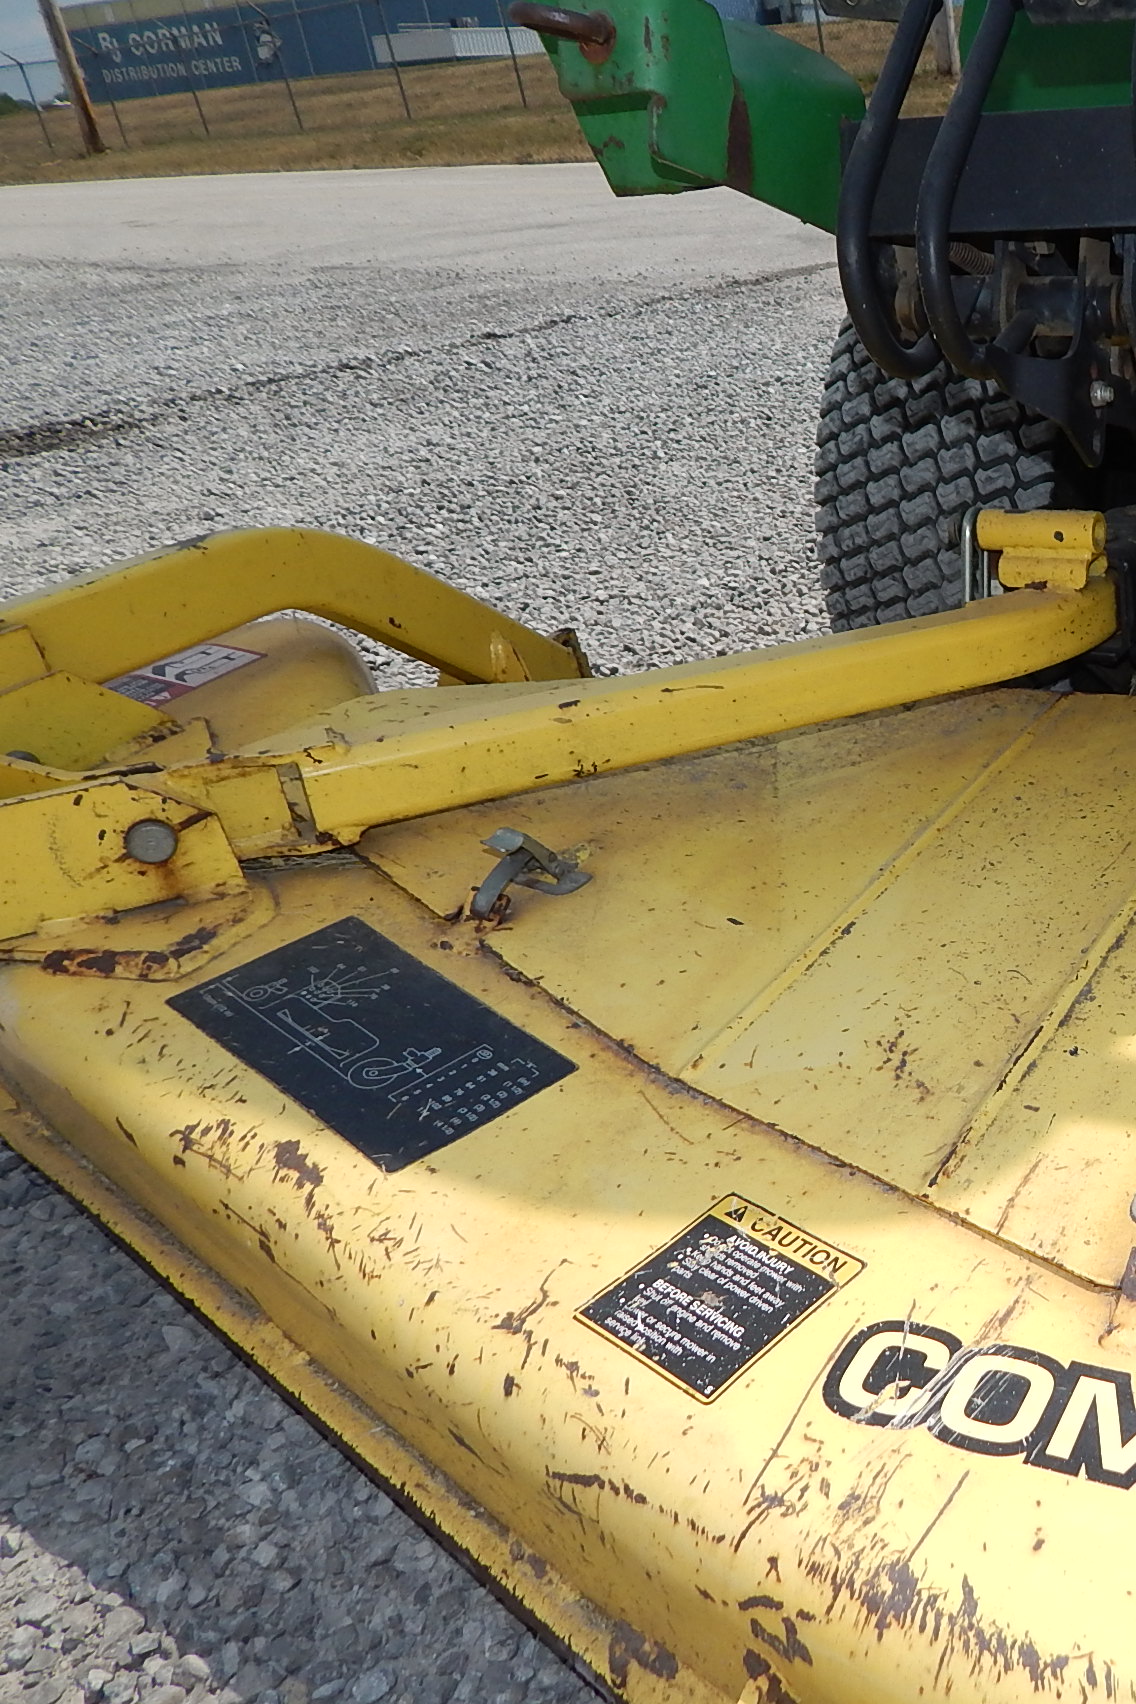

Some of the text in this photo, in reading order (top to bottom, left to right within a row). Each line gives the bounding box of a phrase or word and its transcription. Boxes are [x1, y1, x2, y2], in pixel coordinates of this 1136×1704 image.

[128, 22, 223, 56] CORMAN
[102, 56, 242, 83] DISTRIBUTION CENTER
[699, 1243, 759, 1278] shds removed
[726, 1235, 794, 1274] AVOID INJURY
[751, 1216, 847, 1273] CAUTION
[671, 1265, 692, 1279] parts
[698, 1266, 719, 1279] clear
[716, 1276, 728, 1284] of
[723, 1282, 750, 1299] power
[747, 1295, 775, 1312] driven
[710, 1261, 734, 1276] hands
[732, 1273, 750, 1285] and
[747, 1282, 765, 1294] feet
[760, 1291, 785, 1308] away
[731, 1250, 761, 1268] operate
[759, 1266, 786, 1282] mower
[784, 1279, 804, 1292] with
[603, 1317, 632, 1336] service
[642, 1287, 663, 1300] Shut
[668, 1304, 696, 1323] engine
[694, 1318, 714, 1331] and
[710, 1329, 741, 1350] remove
[652, 1279, 745, 1337] BEFORE SERVICING
[614, 1309, 685, 1355] raised position with
[653, 1322, 682, 1340] secure
[679, 1337, 708, 1357] mower
